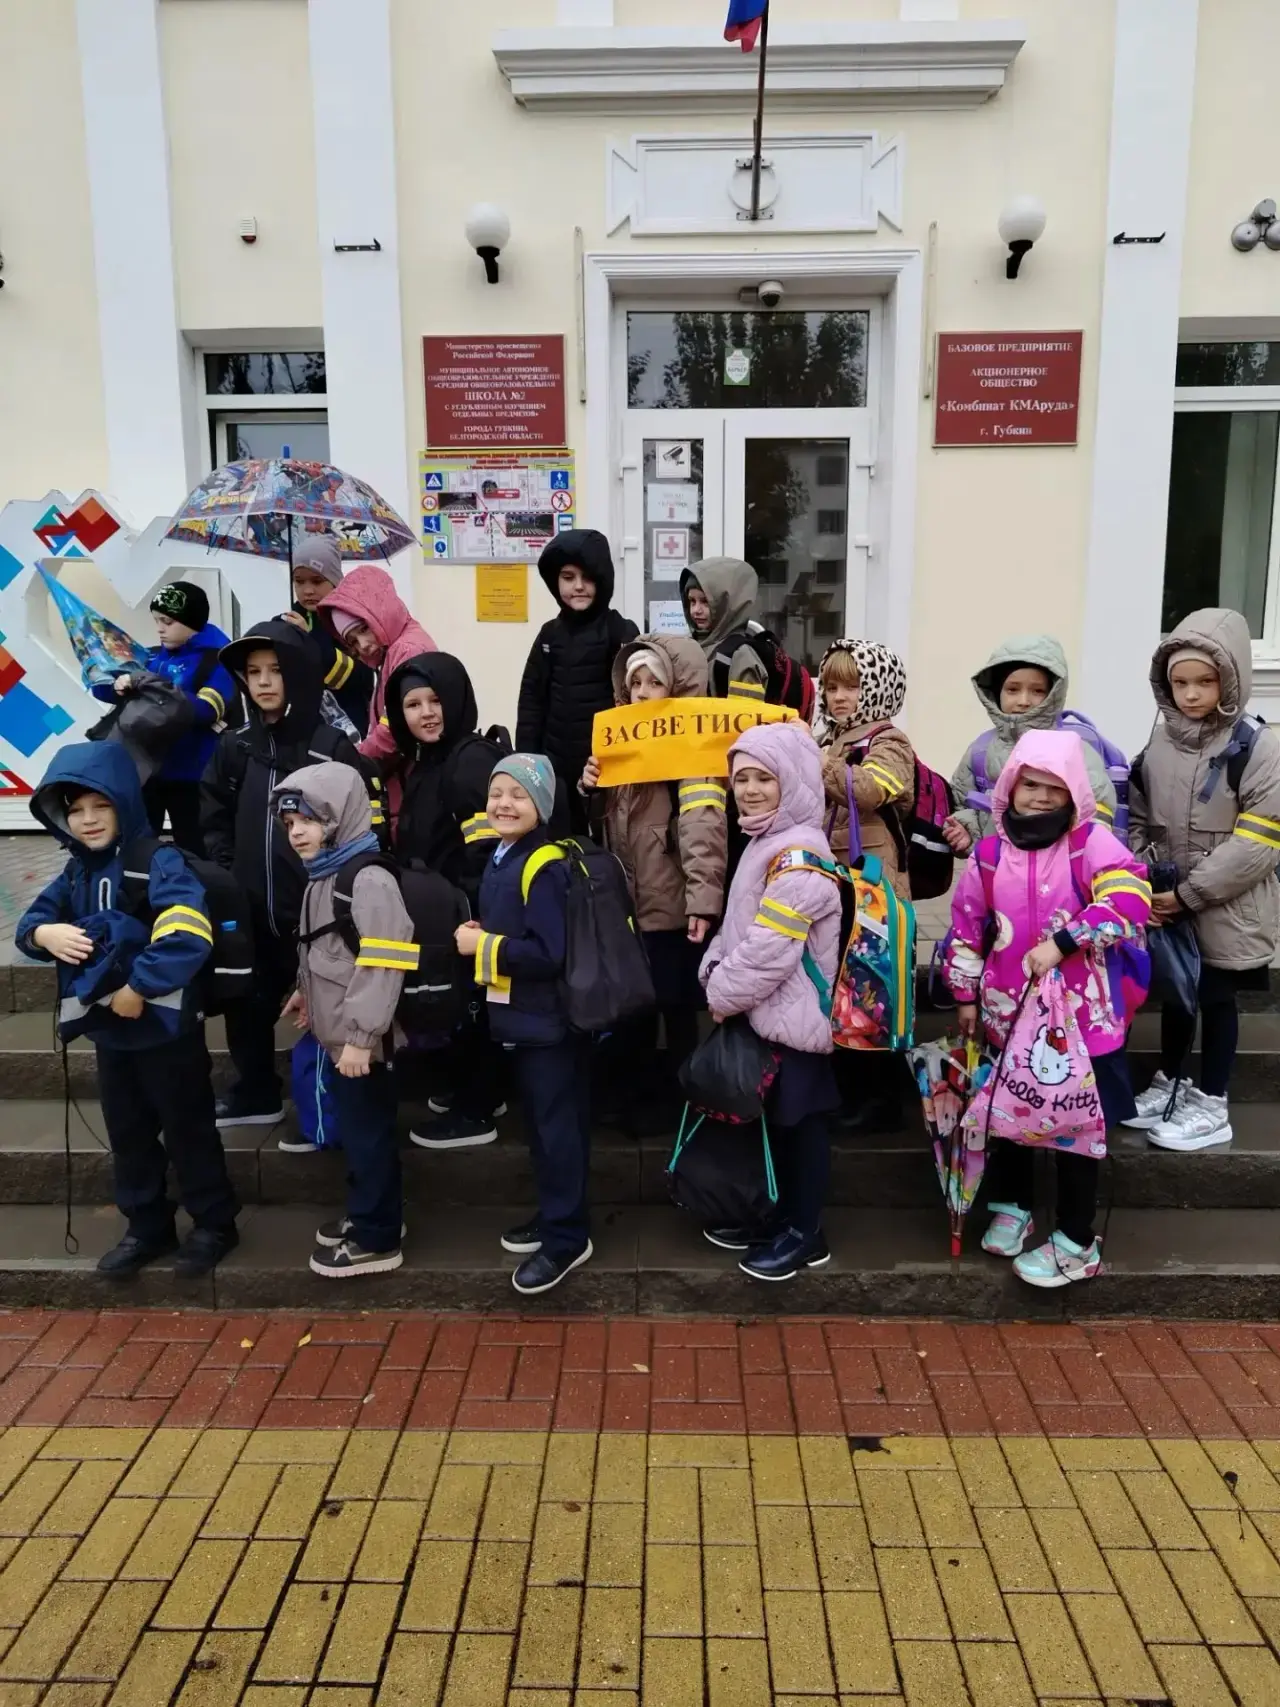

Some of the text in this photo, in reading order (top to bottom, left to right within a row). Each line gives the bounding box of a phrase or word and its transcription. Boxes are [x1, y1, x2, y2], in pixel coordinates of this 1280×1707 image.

[948, 343, 1073, 352] БАЗОВОЕ ПРЕДПРИЯТИЕ
[970, 367, 1049, 377] АКЦИОНЕРНОЕ
[980, 378, 1038, 388] ОБЩЕСТВО
[464, 391, 507, 400] ШКОЛА
[940, 399, 1075, 413] «Комбинат КМАруда»
[980, 425, 1032, 438] г. Губкин
[999, 1071, 1099, 1117] Hello Kitty
